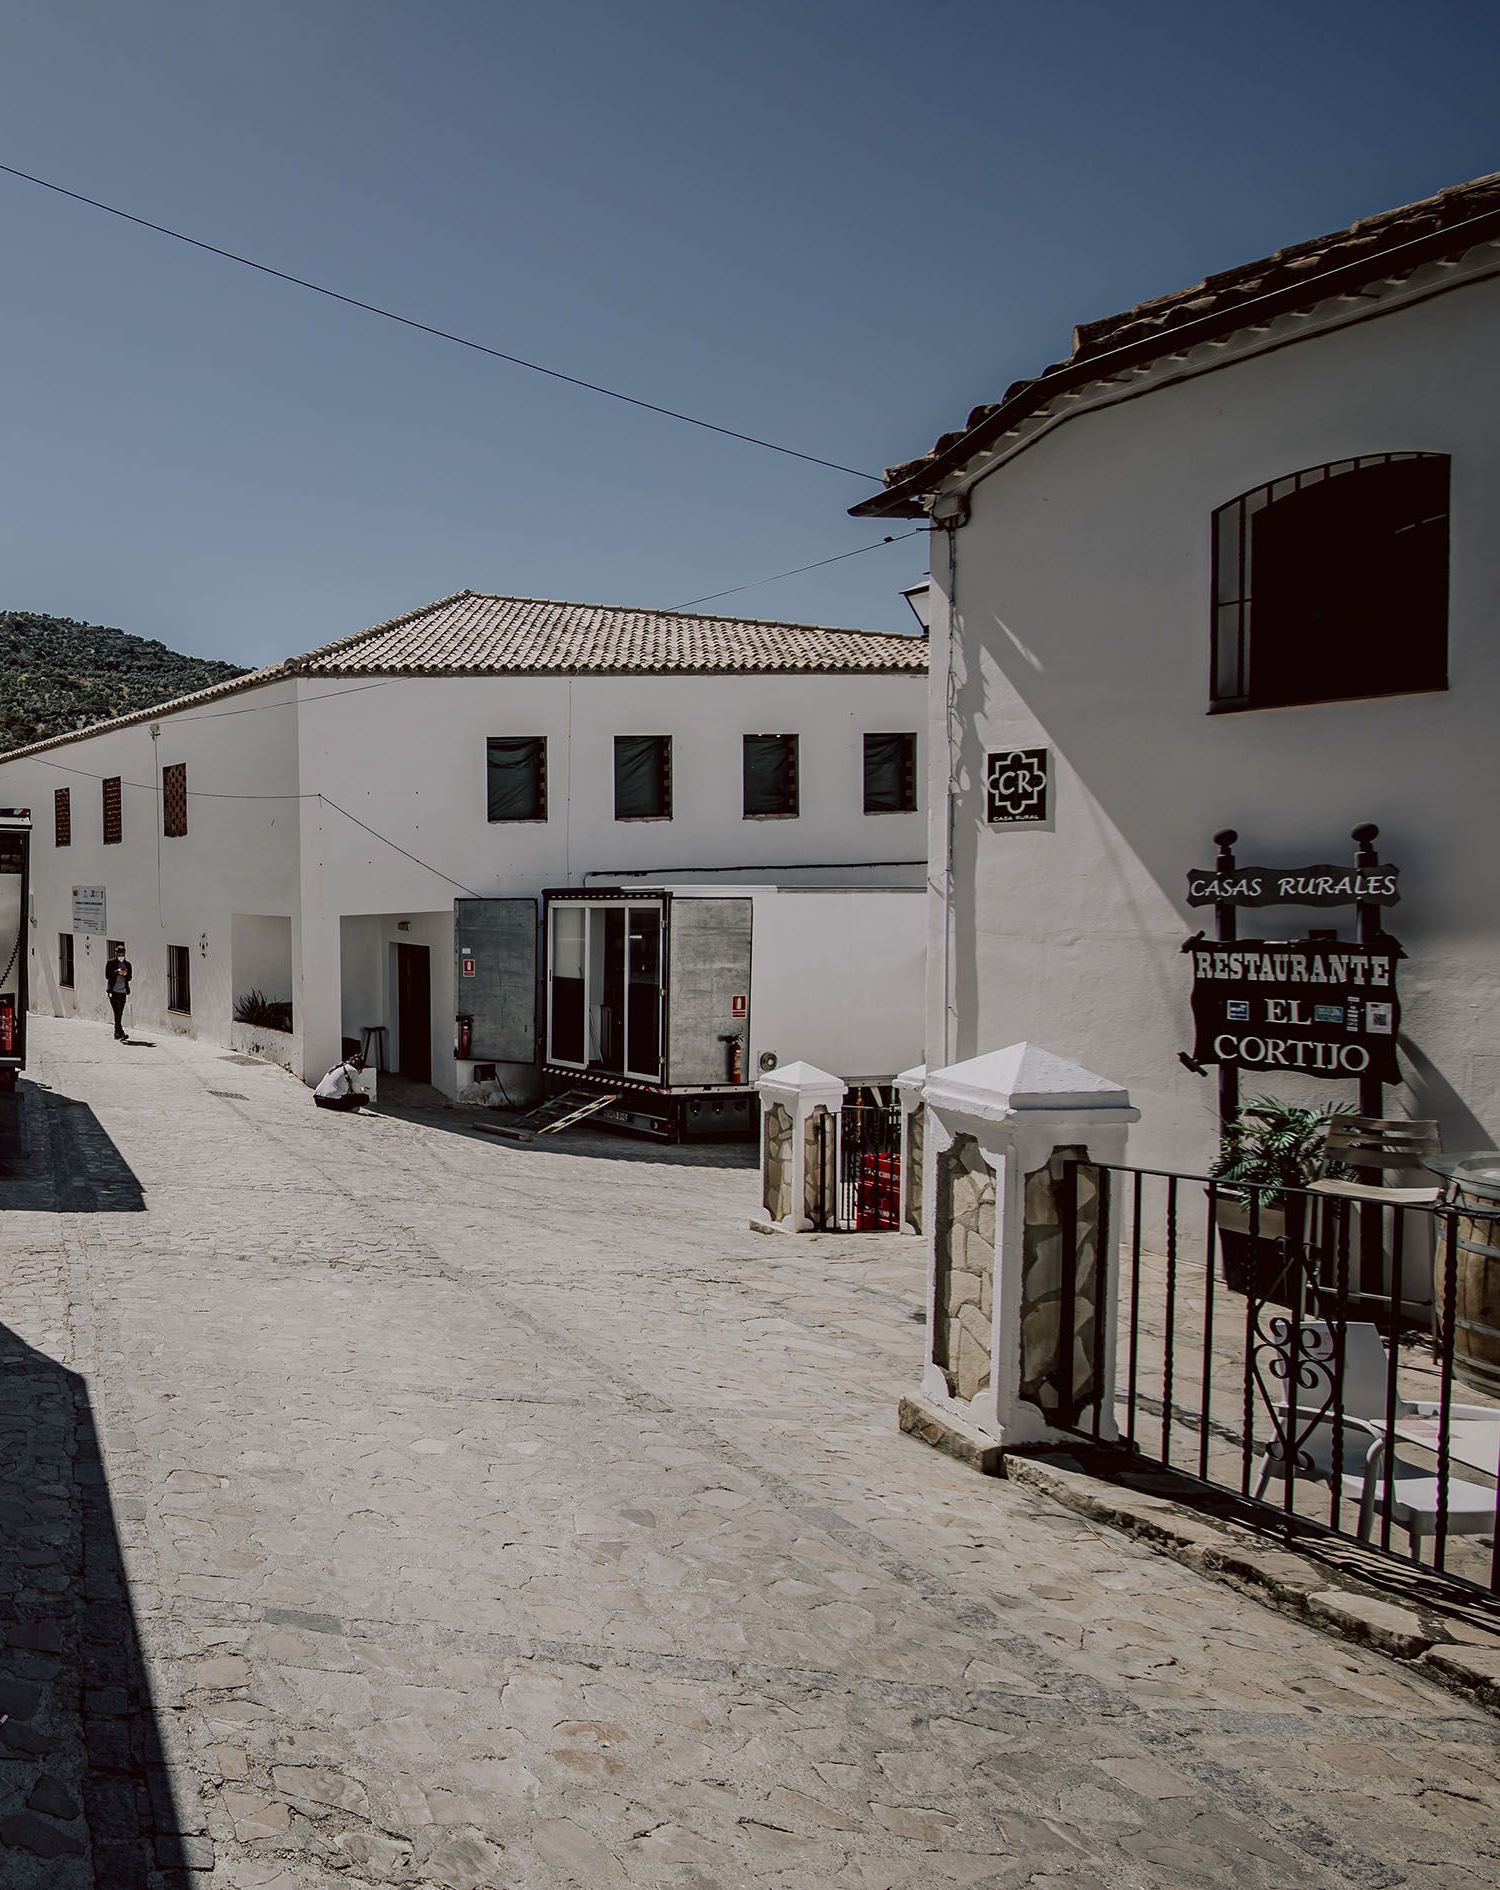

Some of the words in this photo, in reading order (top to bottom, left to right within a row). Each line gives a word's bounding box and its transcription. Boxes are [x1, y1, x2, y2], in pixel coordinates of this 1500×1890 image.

[999, 770, 1033, 795] CR
[1189, 878, 1263, 897] CASAS
[1277, 875, 1397, 897] RURALES
[1196, 952, 1390, 986] RESTAURANTE
[1263, 998, 1312, 1026] EL
[1213, 1034, 1370, 1072] CORTIJO
